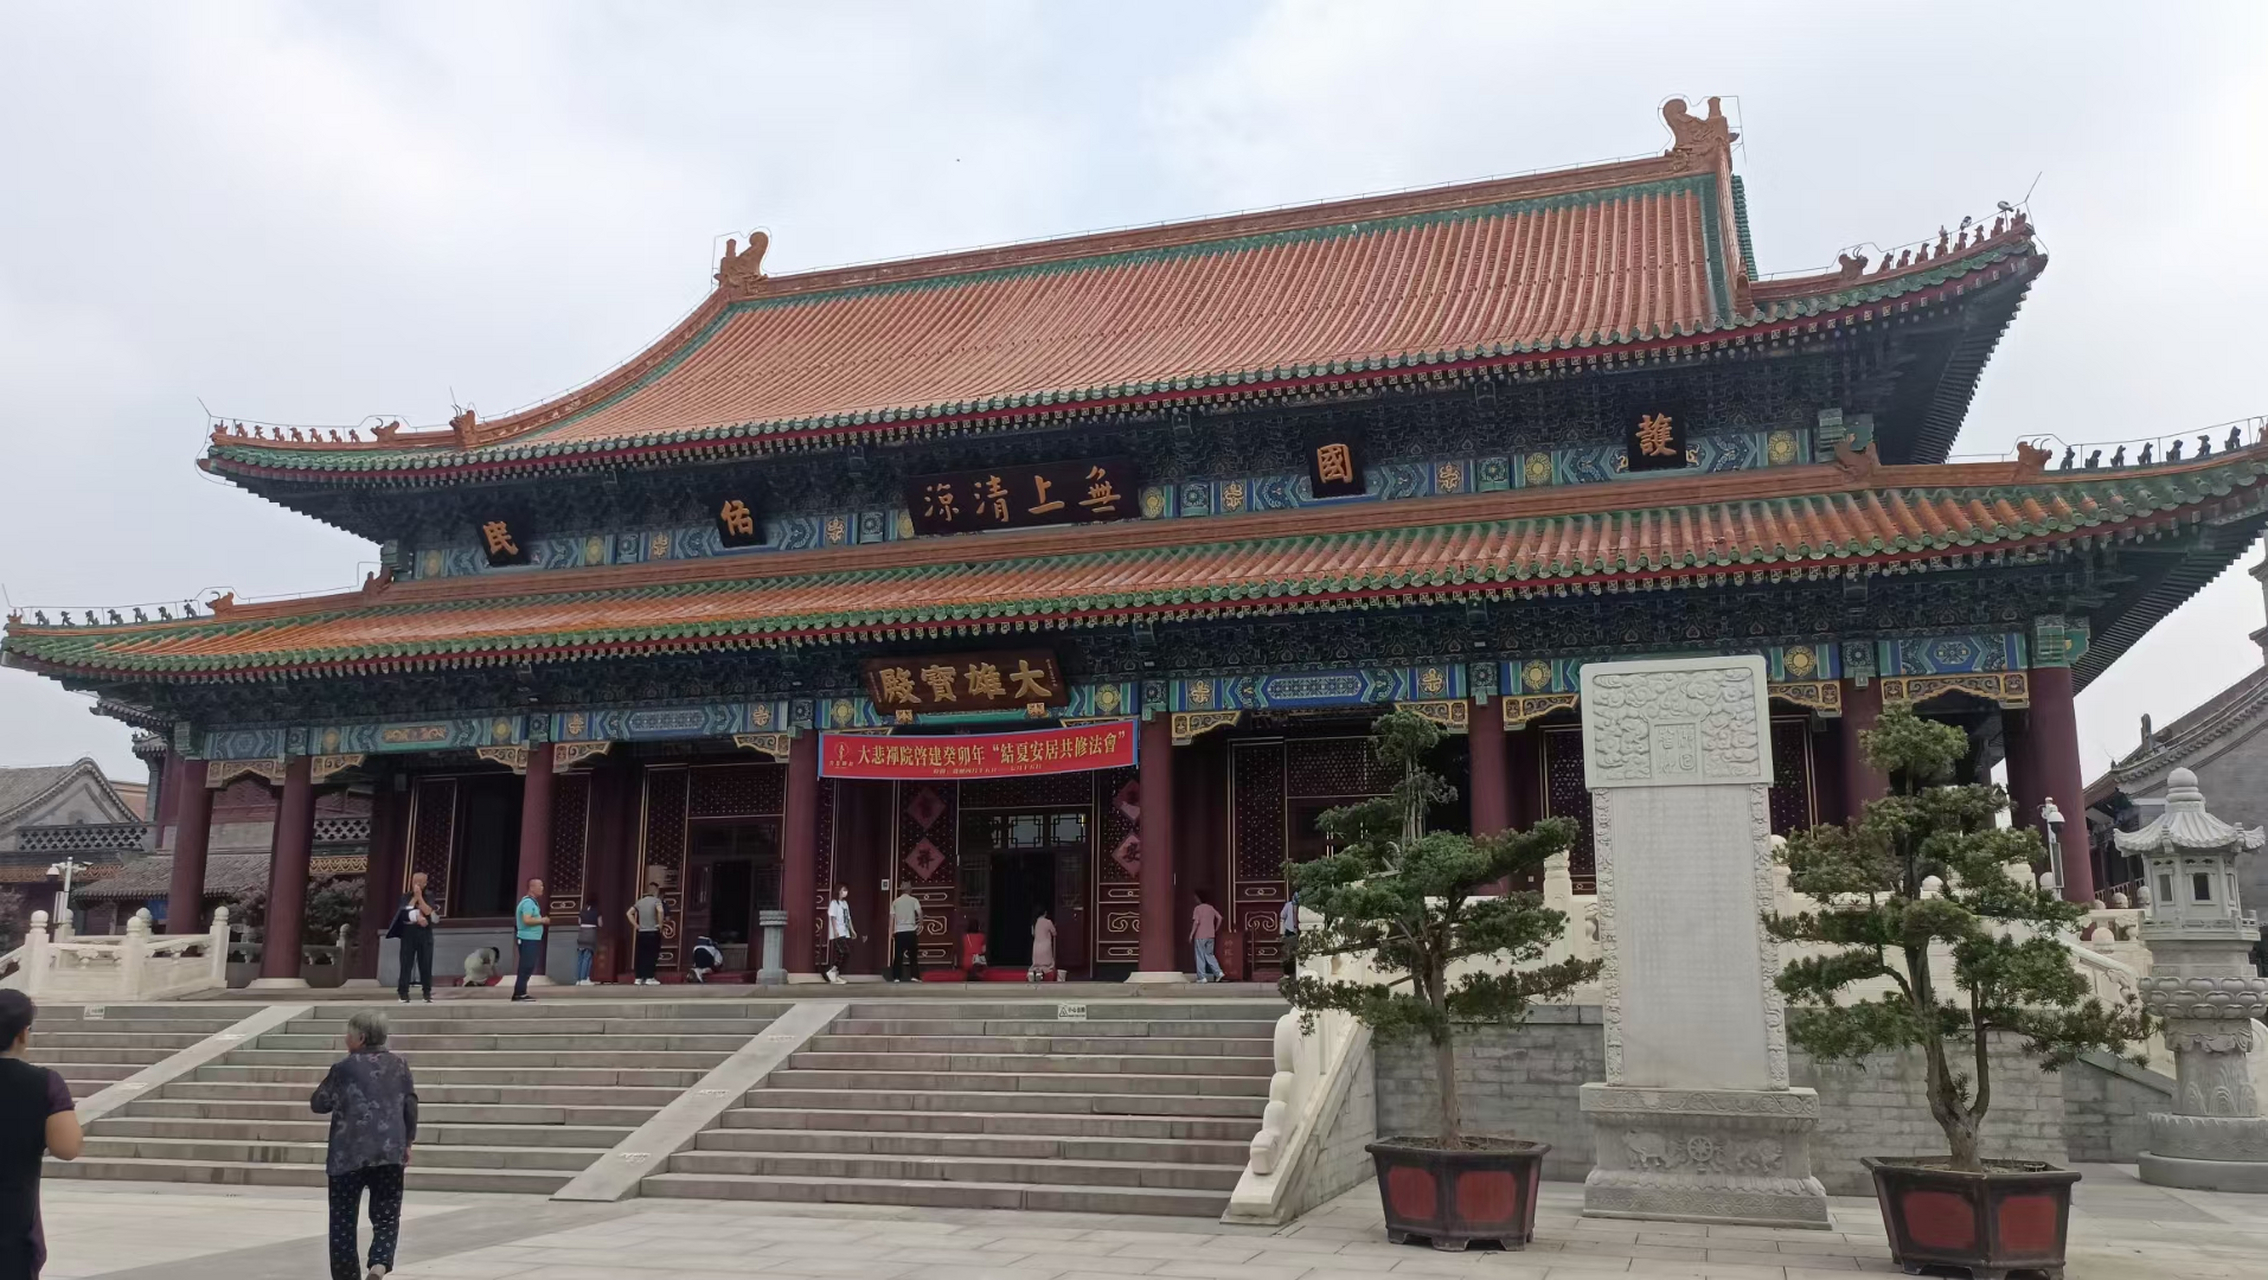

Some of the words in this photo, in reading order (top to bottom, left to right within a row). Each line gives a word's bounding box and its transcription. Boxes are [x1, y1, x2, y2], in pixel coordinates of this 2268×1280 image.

[1635, 412, 1677, 457] 護
[1317, 443, 1353, 483] 國
[483, 520, 519, 555] 民
[720, 500, 753, 536] 佑
[879, 659, 1052, 704] 大雄寶殿
